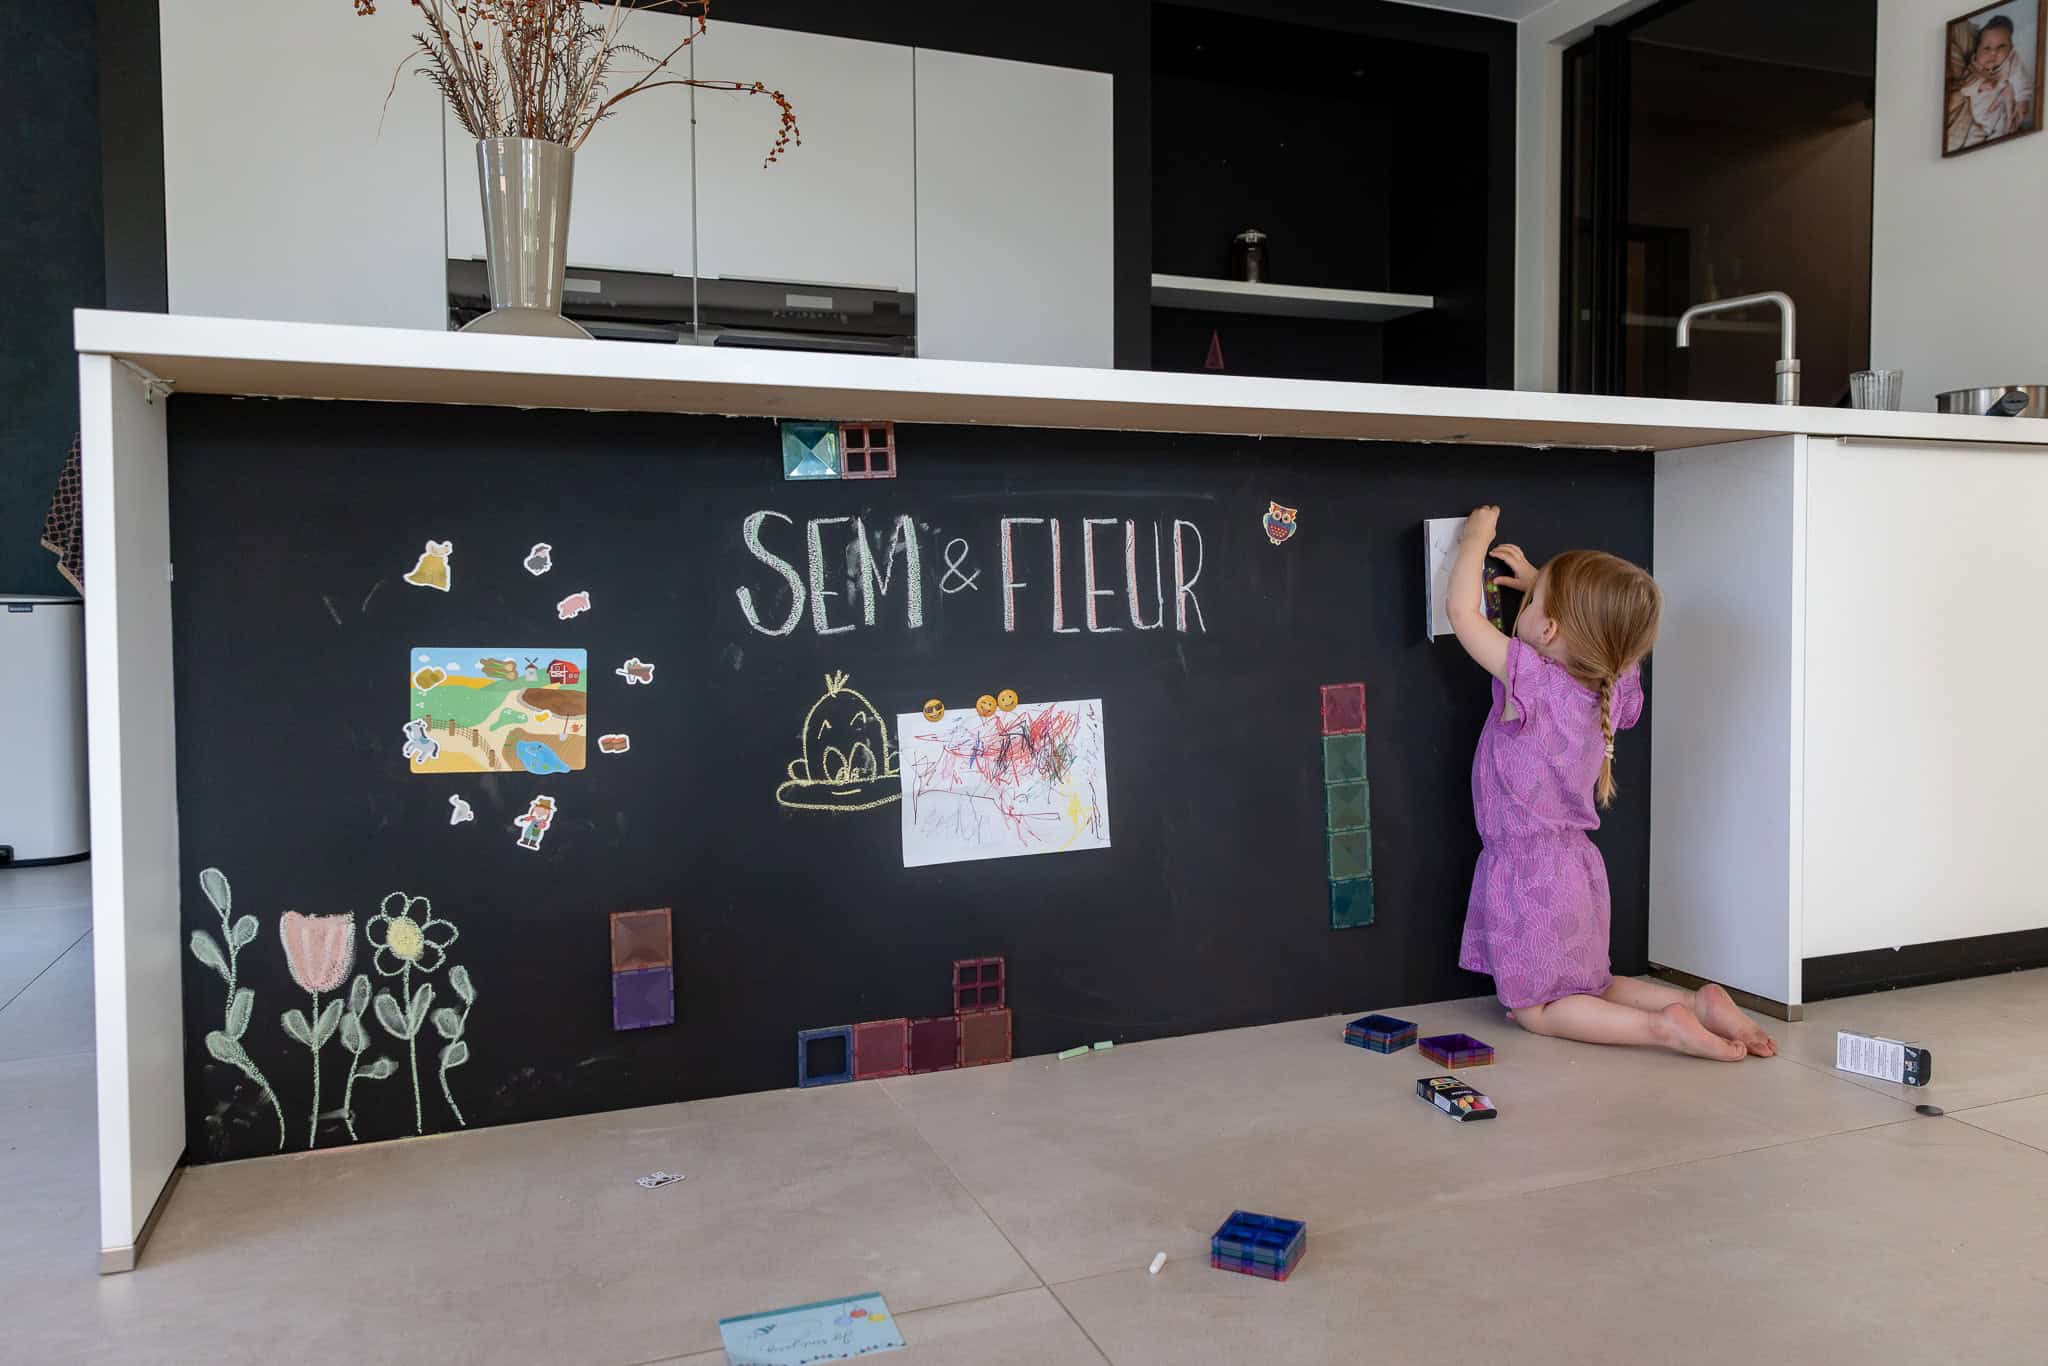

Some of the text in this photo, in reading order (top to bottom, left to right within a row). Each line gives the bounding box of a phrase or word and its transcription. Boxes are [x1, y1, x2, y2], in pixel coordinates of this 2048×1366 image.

[735, 509, 1207, 637] SEM & FLEUR
